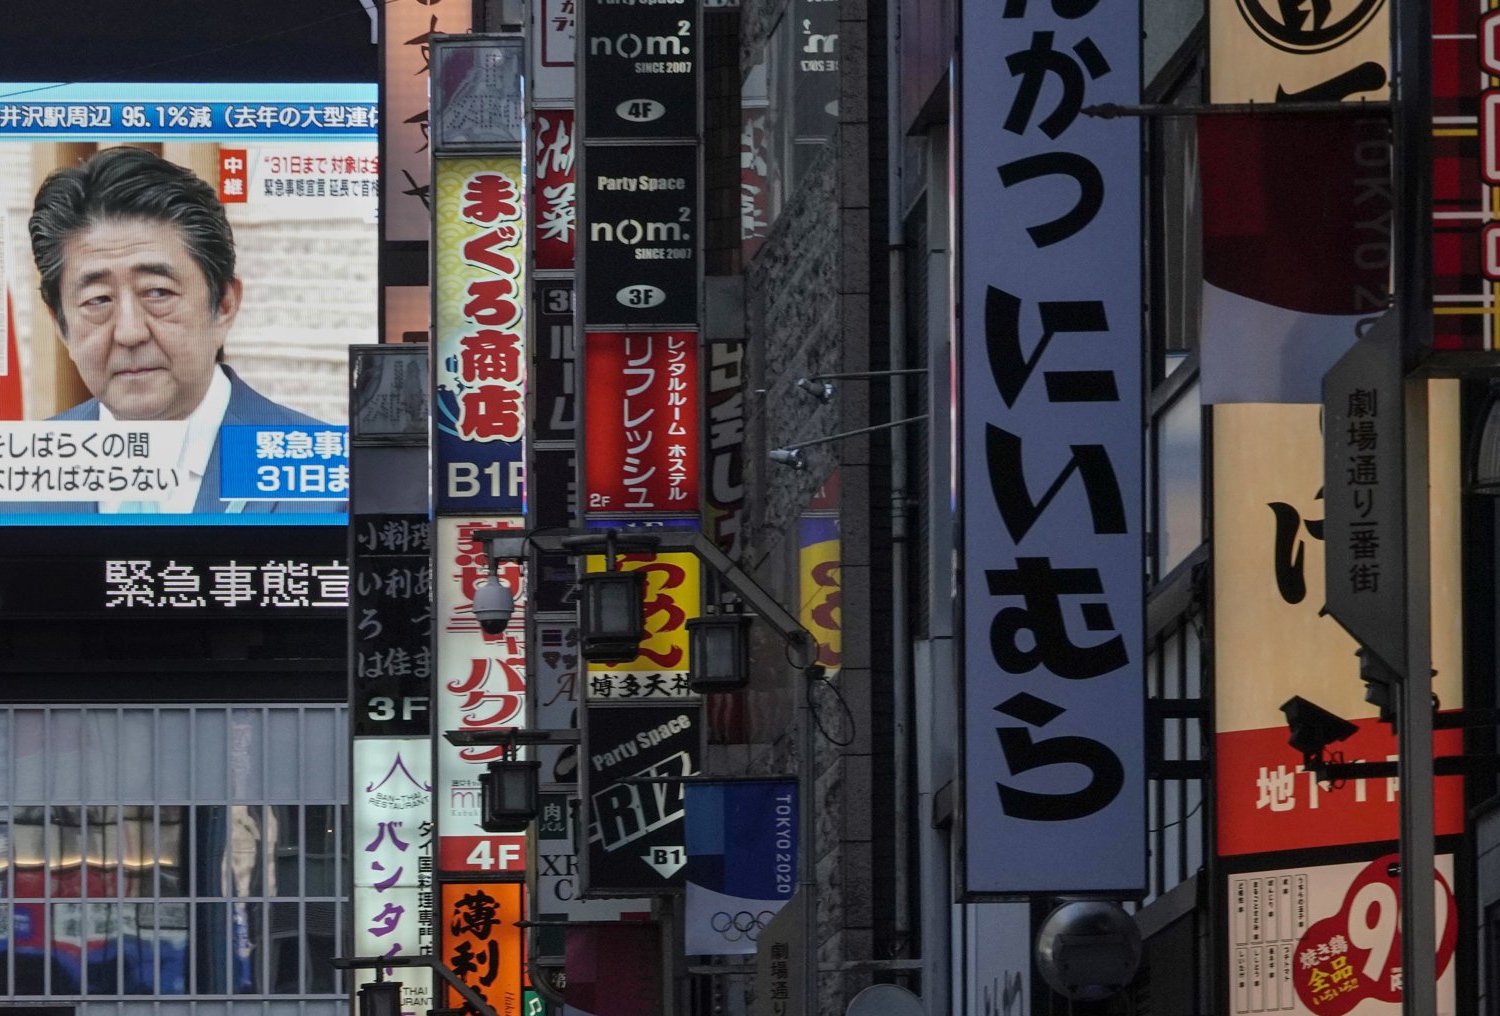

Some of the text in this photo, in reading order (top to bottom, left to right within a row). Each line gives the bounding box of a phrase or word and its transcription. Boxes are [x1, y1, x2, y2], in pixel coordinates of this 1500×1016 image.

[635, 61, 692, 75] SINCE 2007
[627, 101, 653, 121] 4F
[223, 155, 244, 197] 中継
[597, 175, 686, 194] Party Space
[635, 247, 692, 260] SINCE 2007
[461, 172, 525, 443] まぐろ商店
[629, 288, 654, 306] 3F
[622, 335, 657, 508] リフレッシュ
[667, 335, 688, 501] レンタルルーム ホステル
[256, 430, 350, 460] 緊急事
[589, 493, 612, 508] 2F
[1346, 387, 1381, 595] 劇場通り一番街
[366, 696, 428, 722] 3F
[592, 714, 692, 773] Party Space
[465, 840, 521, 870] 4F
[653, 850, 682, 865] B1
[775, 794, 793, 894] TOKYO 2020
[1307, 955, 1355, 994] 全品
